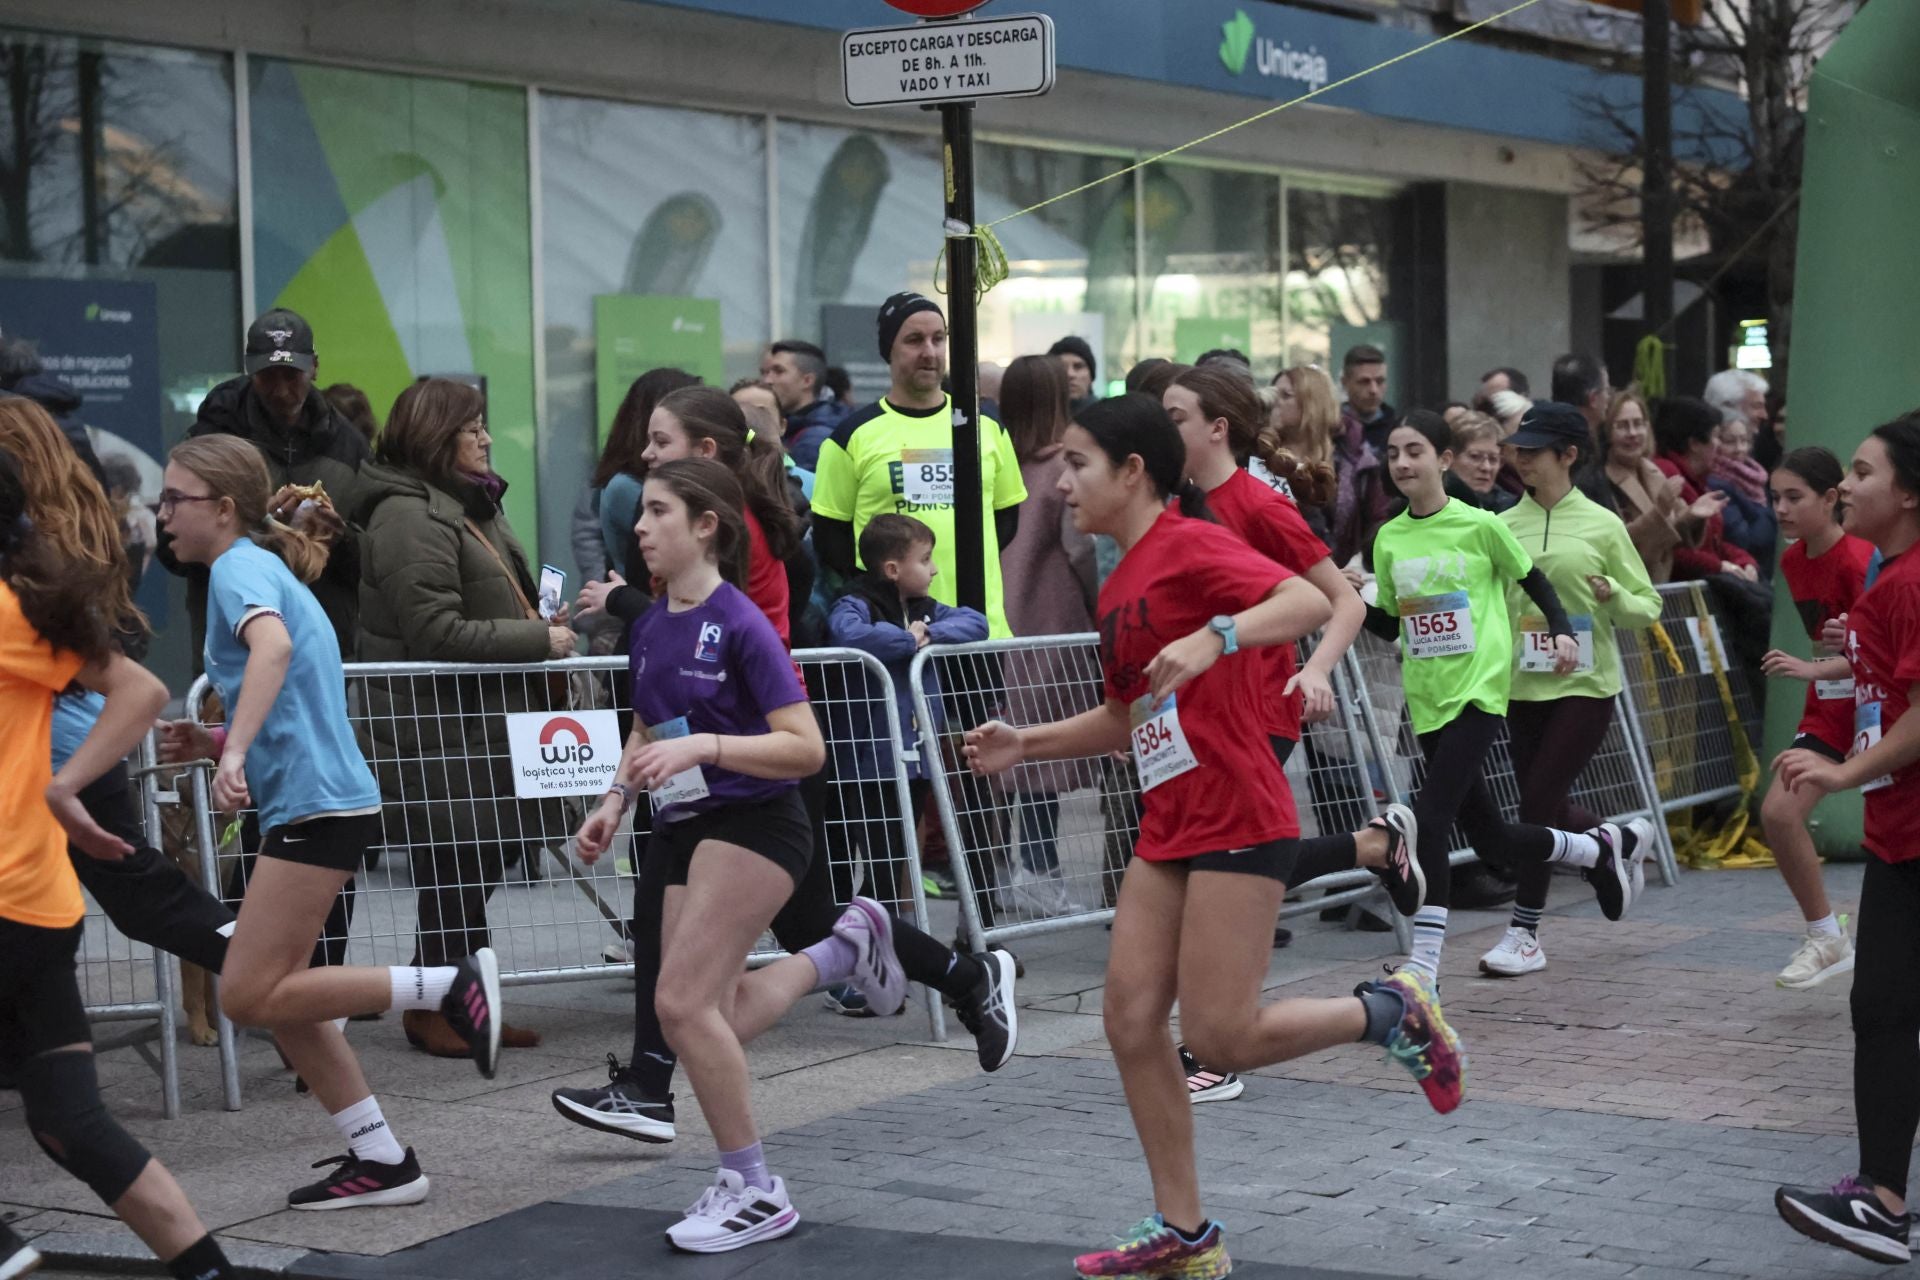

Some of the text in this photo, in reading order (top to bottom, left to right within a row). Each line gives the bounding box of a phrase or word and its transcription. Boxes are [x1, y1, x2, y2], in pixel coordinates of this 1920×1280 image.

[850, 27, 1038, 57] EXCEPTO CARGA Y DESCARGA
[902, 53, 986, 72] DE 8h. A 11h.
[1256, 37, 1327, 92] Unicaja
[900, 72, 991, 93] VADO Y TAXI
[1410, 611, 1458, 636] 1563
[1133, 716, 1172, 758] 1584
[568, 766, 575, 779] y
[578, 763, 616, 774] eventos
[558, 781, 573, 789] 635
[574, 780, 588, 788] 590
[588, 779, 603, 787] 995
[351, 1118, 385, 1140] adidas
